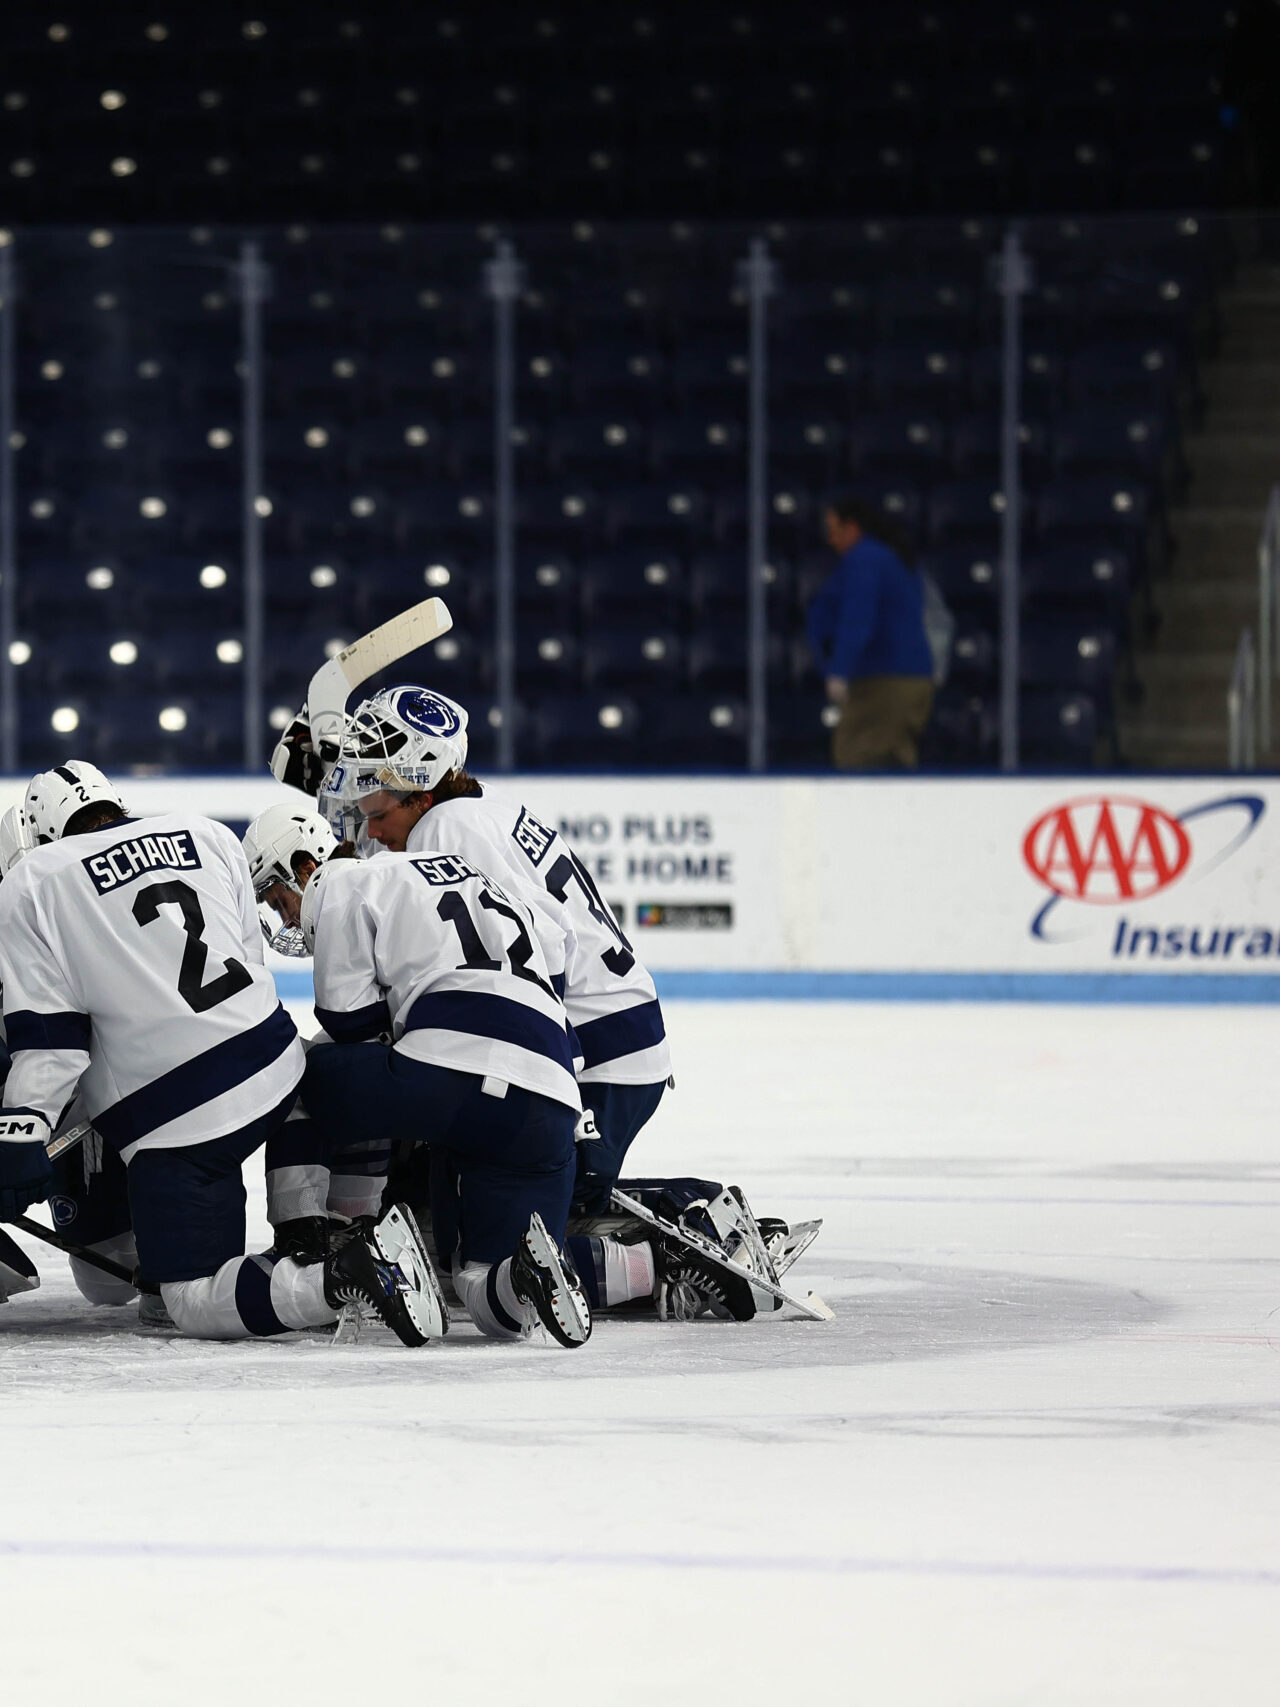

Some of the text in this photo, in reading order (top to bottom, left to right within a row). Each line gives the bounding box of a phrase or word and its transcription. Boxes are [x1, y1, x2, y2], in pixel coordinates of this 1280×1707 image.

[75, 786, 90, 802] 2
[515, 812, 556, 862] SEIF
[624, 815, 712, 845] PLUS
[1042, 798, 1176, 899] AAA
[89, 833, 197, 889] SCHADE
[627, 855, 731, 883] HOME
[132, 879, 254, 1013] 2
[1114, 914, 1280, 958] Insura
